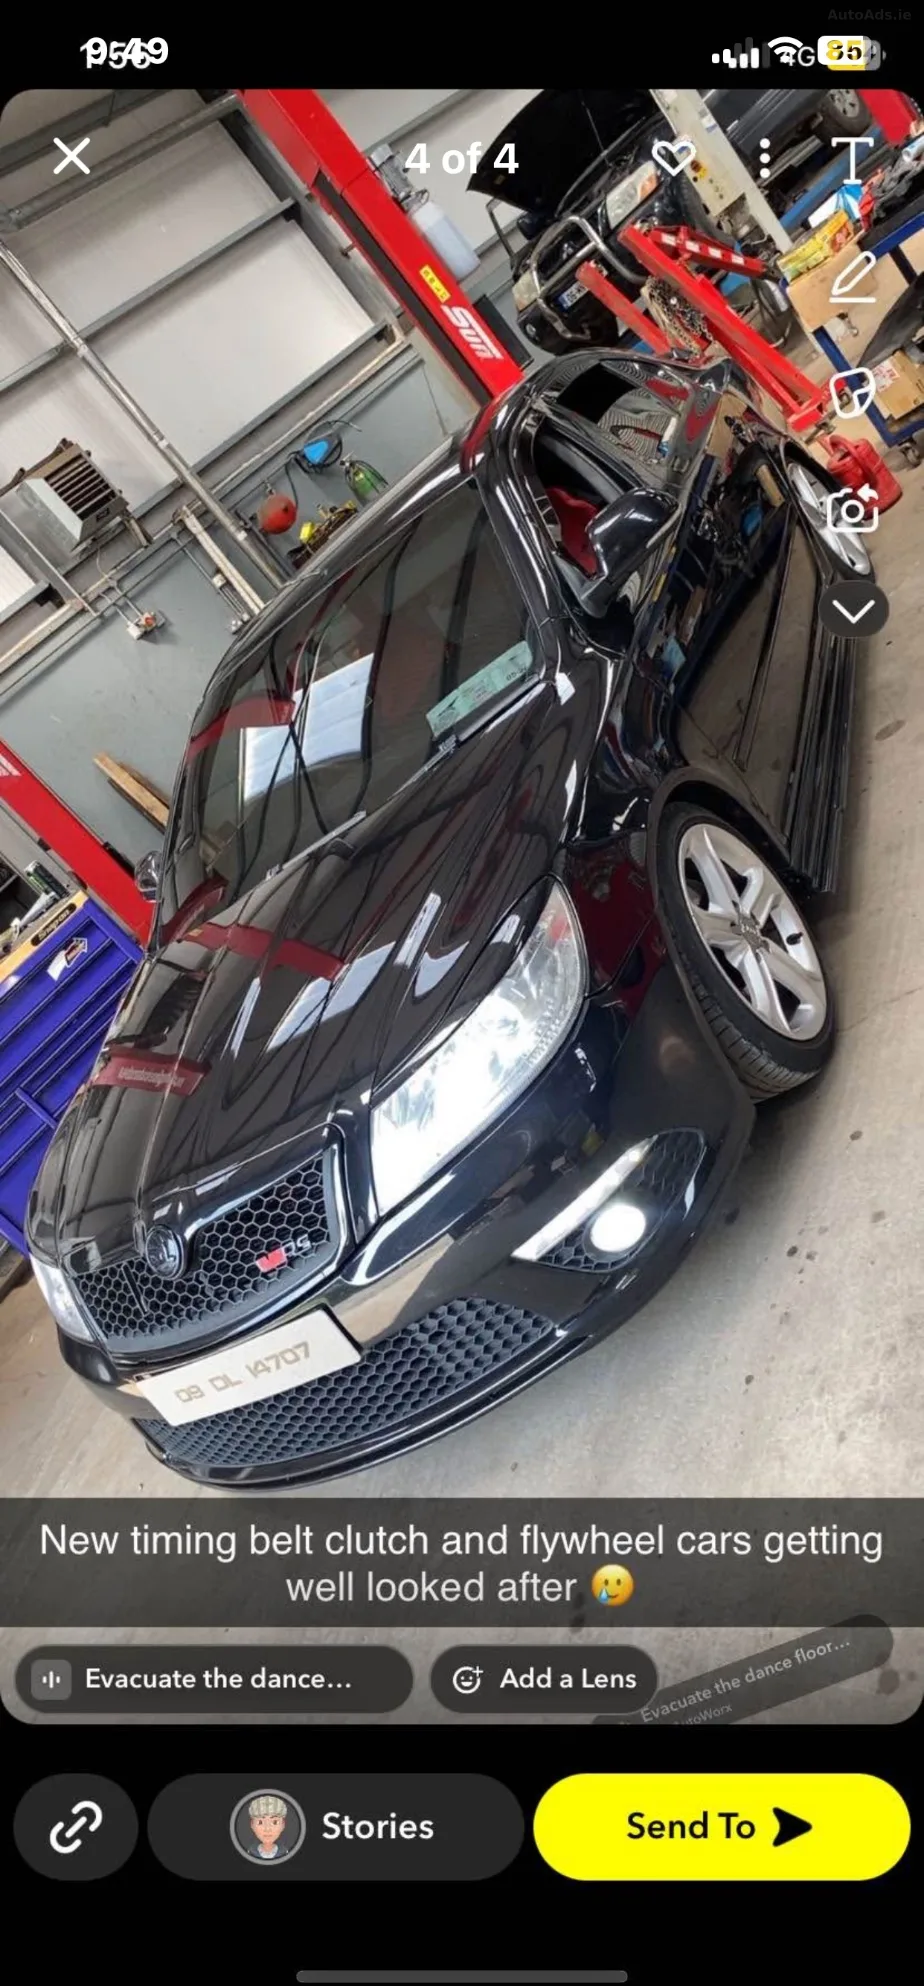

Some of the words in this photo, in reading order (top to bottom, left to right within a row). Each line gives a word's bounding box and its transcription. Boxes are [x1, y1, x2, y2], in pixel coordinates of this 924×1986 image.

[174, 1384, 205, 1404] 09
[208, 1374, 243, 1392] DL
[245, 1341, 311, 1378] 14707
